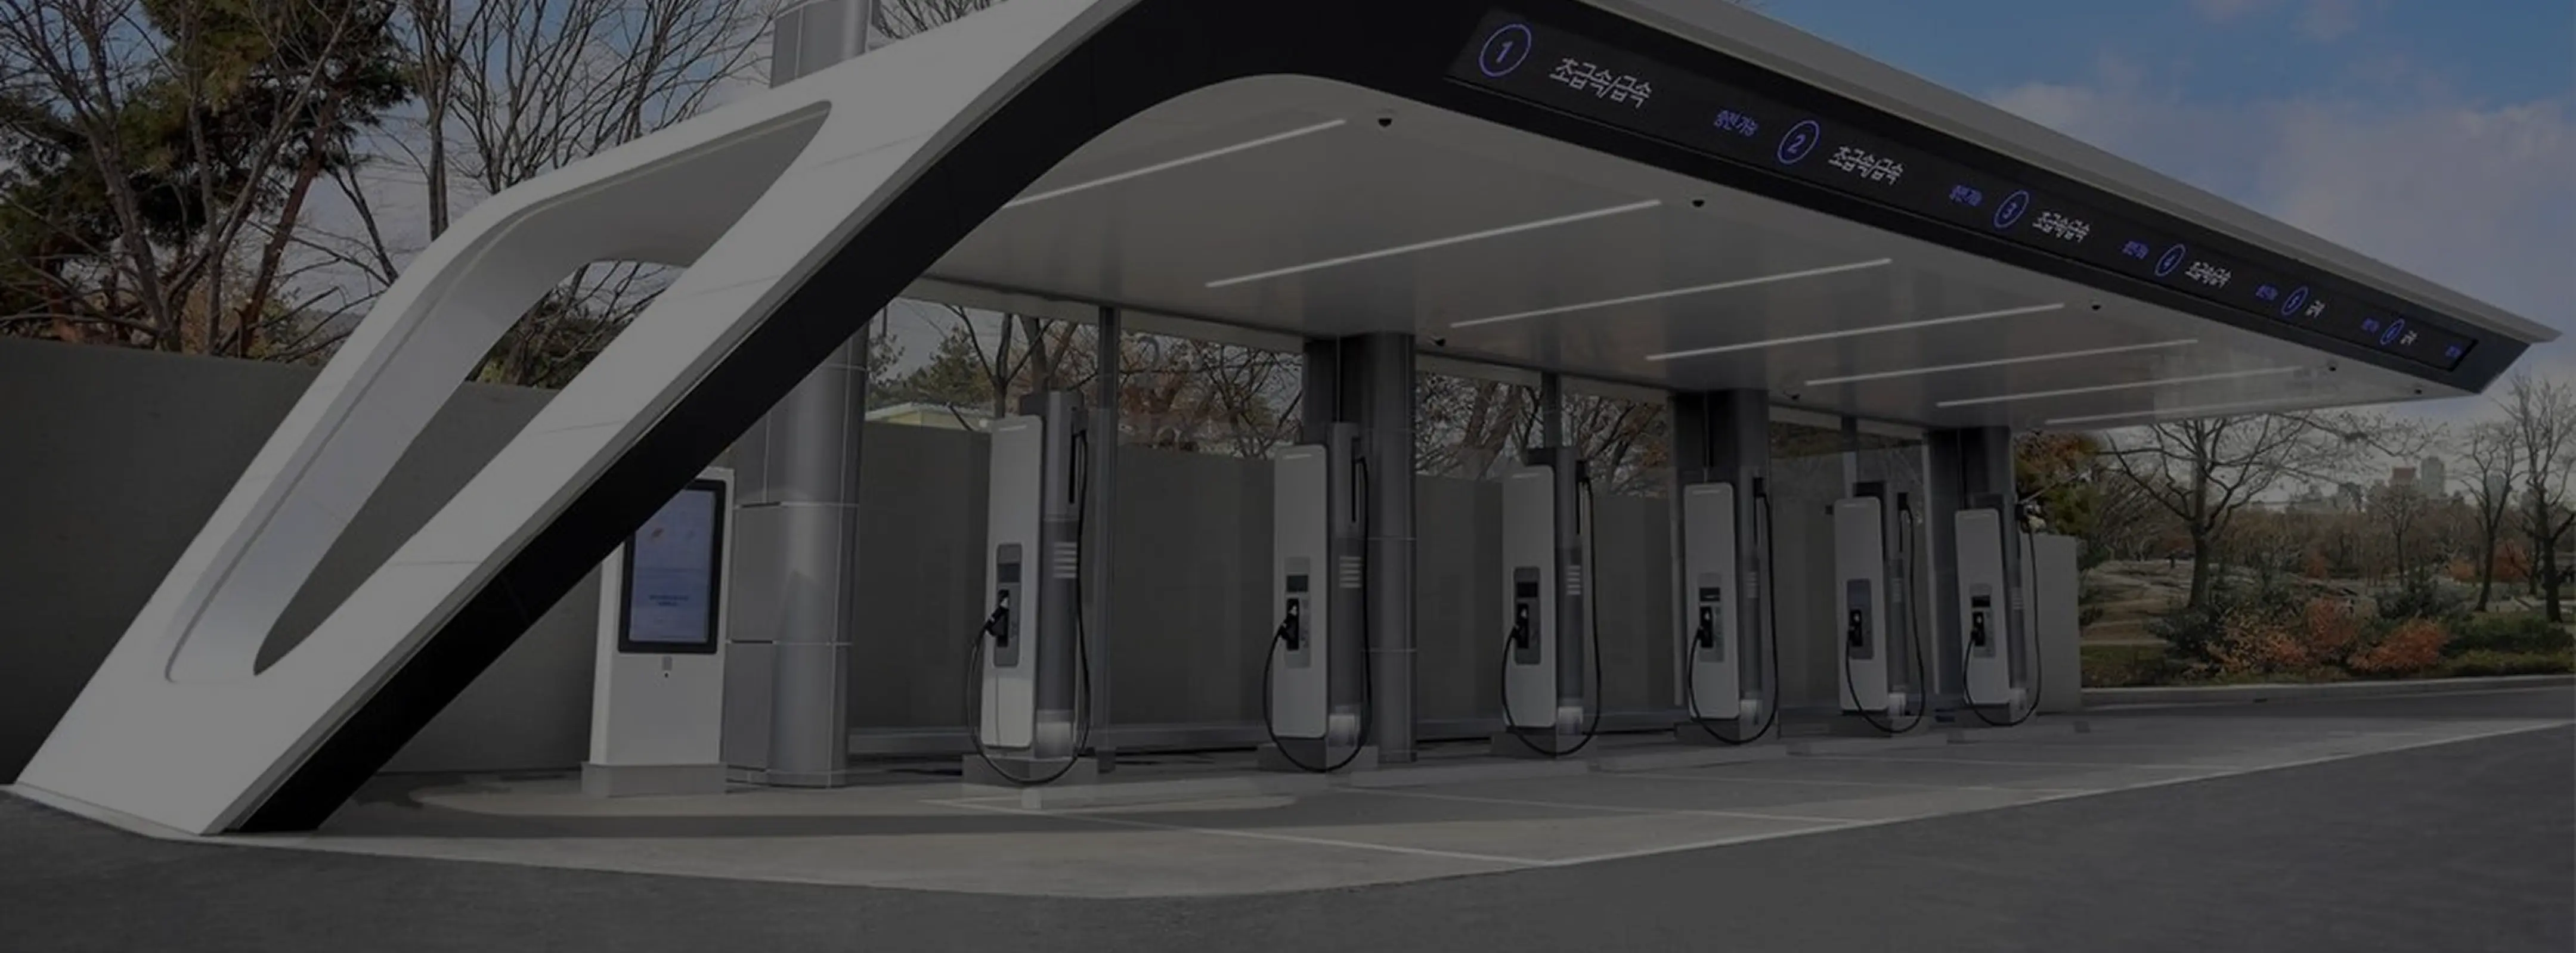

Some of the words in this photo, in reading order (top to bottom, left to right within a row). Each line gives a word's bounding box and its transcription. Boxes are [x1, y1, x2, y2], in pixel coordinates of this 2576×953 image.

[1496, 41, 1513, 64] 1
[1549, 58, 1652, 108] 초급속/급속
[1787, 134, 1806, 154] 2
[1828, 146, 1903, 186] 초급속/급속
